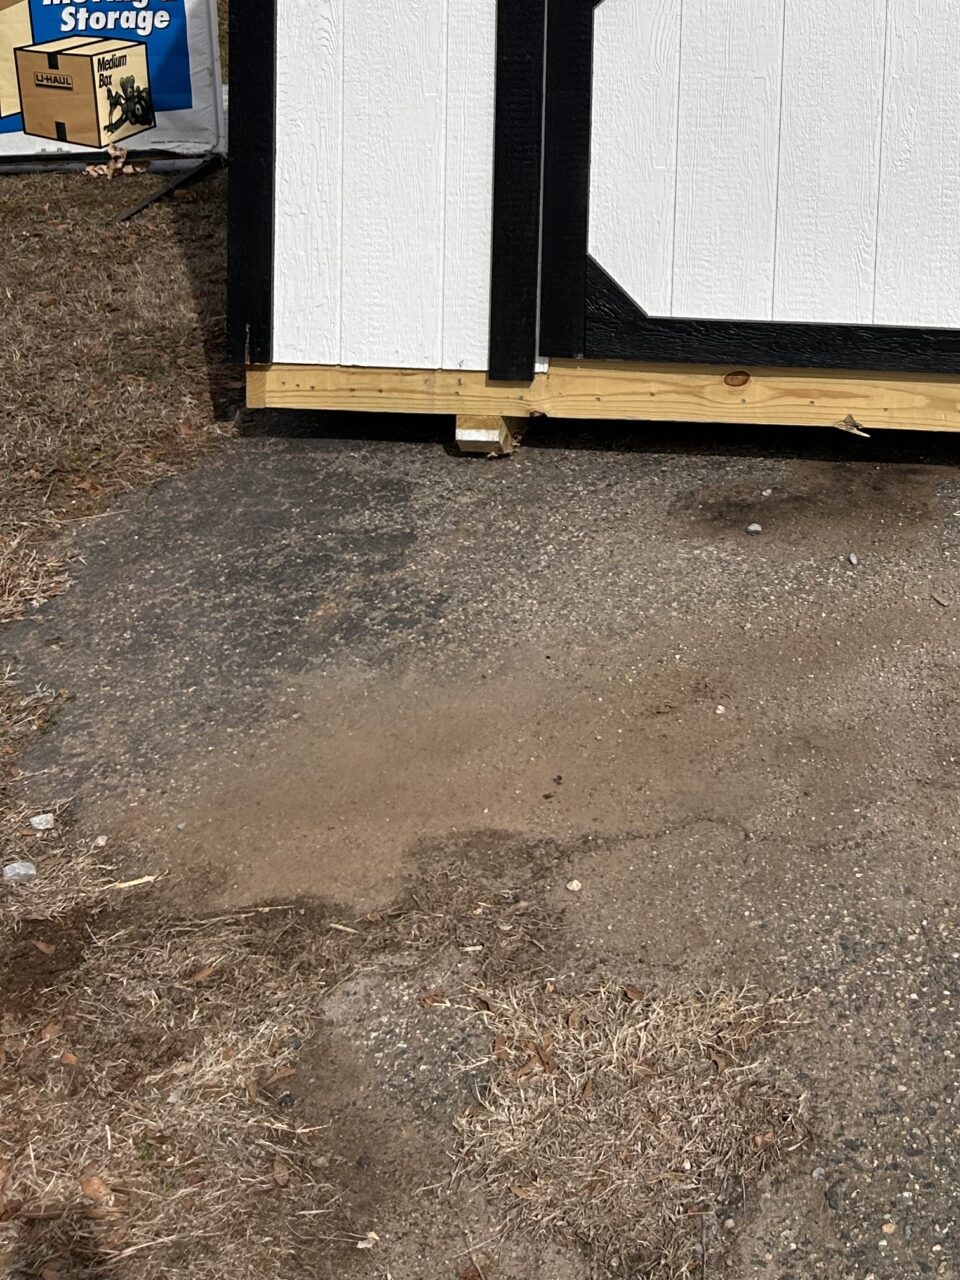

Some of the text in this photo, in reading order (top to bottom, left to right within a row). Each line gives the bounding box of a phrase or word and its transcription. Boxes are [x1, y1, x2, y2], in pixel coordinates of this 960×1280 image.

[60, 6, 170, 36] Storage
[97, 54, 127, 73] Medium
[35, 73, 72, 86] U-HAUL
[98, 73, 113, 89] Box
